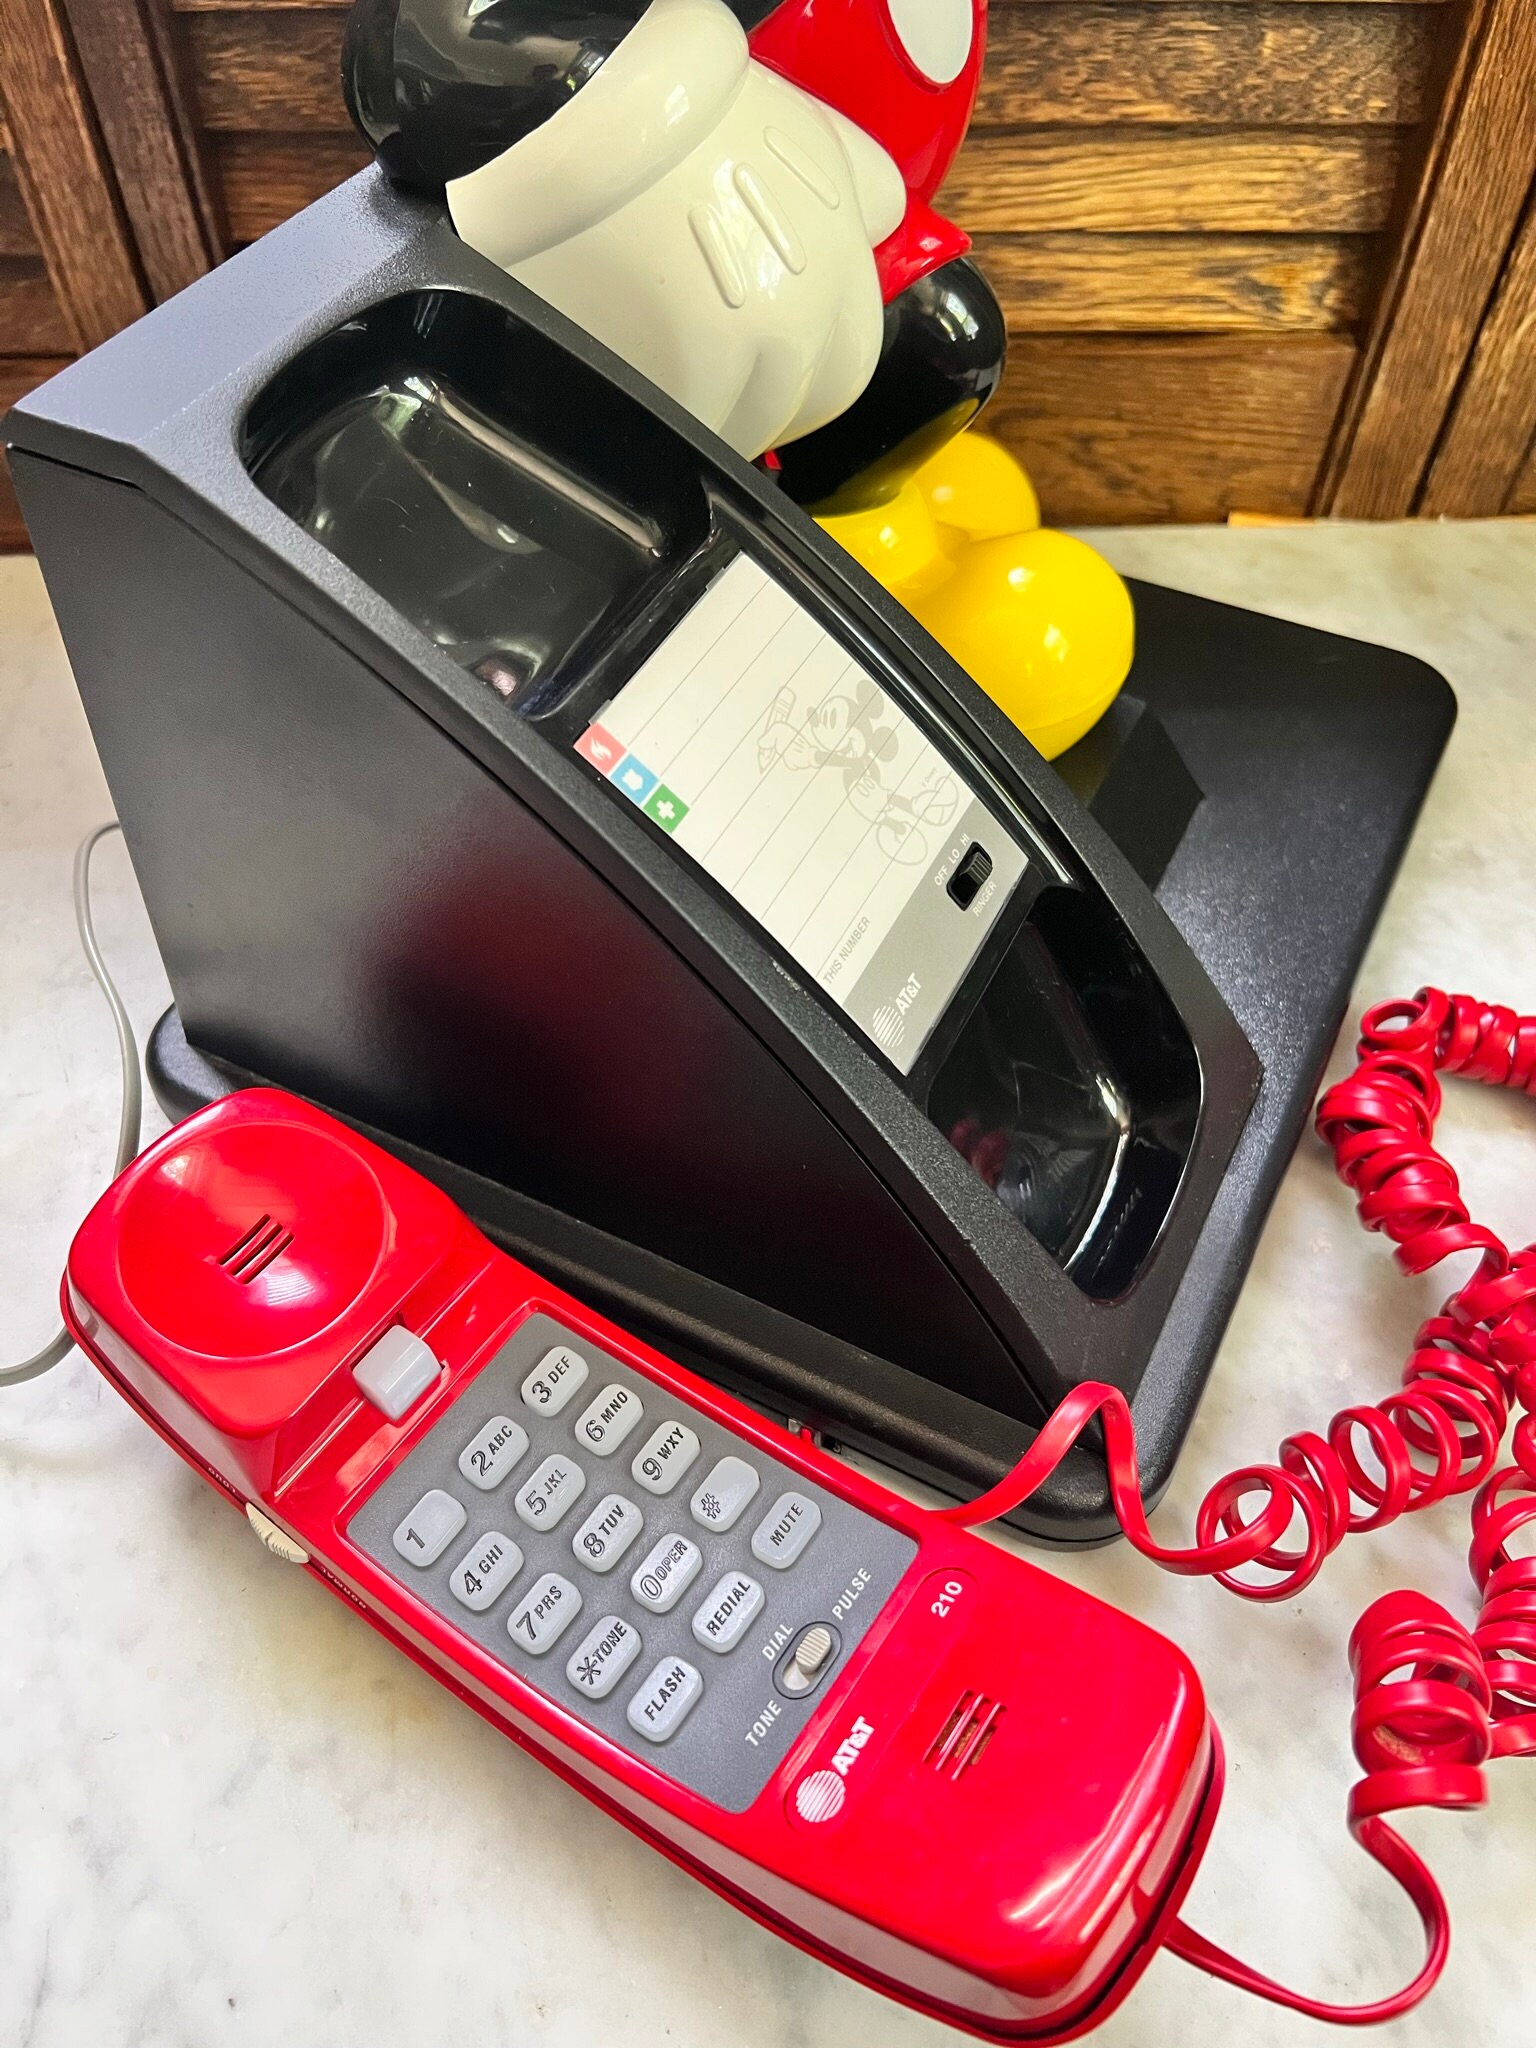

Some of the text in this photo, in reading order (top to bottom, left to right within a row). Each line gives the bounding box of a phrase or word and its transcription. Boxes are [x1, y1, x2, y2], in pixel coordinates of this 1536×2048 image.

[934, 833, 971, 887] OFF LO HI
[971, 881, 998, 917] RINGER
[822, 915, 871, 985] THIS NUMBER
[895, 972, 922, 1016] AT&T
[532, 1355, 572, 1404] 3 DEF
[585, 1391, 628, 1443] 6 MNO
[471, 1425, 513, 1477] 2 ABC
[642, 1427, 684, 1481] 9 WXY
[525, 1469, 567, 1516] 5 JKL
[406, 1527, 426, 1549] 1
[583, 1504, 625, 1558] 8 TUV
[769, 1503, 804, 1547] MUTE
[464, 1544, 504, 1595] 4 GHI
[640, 1540, 688, 1601] 0 OPER
[831, 1567, 872, 1620] PULSE
[516, 1585, 562, 1641] 7 PRS
[705, 1580, 751, 1636] REDIAL
[931, 1580, 963, 1618] 210
[761, 1623, 794, 1661] DIAL
[644, 1665, 686, 1721] FLASH
[744, 1700, 781, 1747] TONE
[831, 1715, 875, 1776] AT&T
